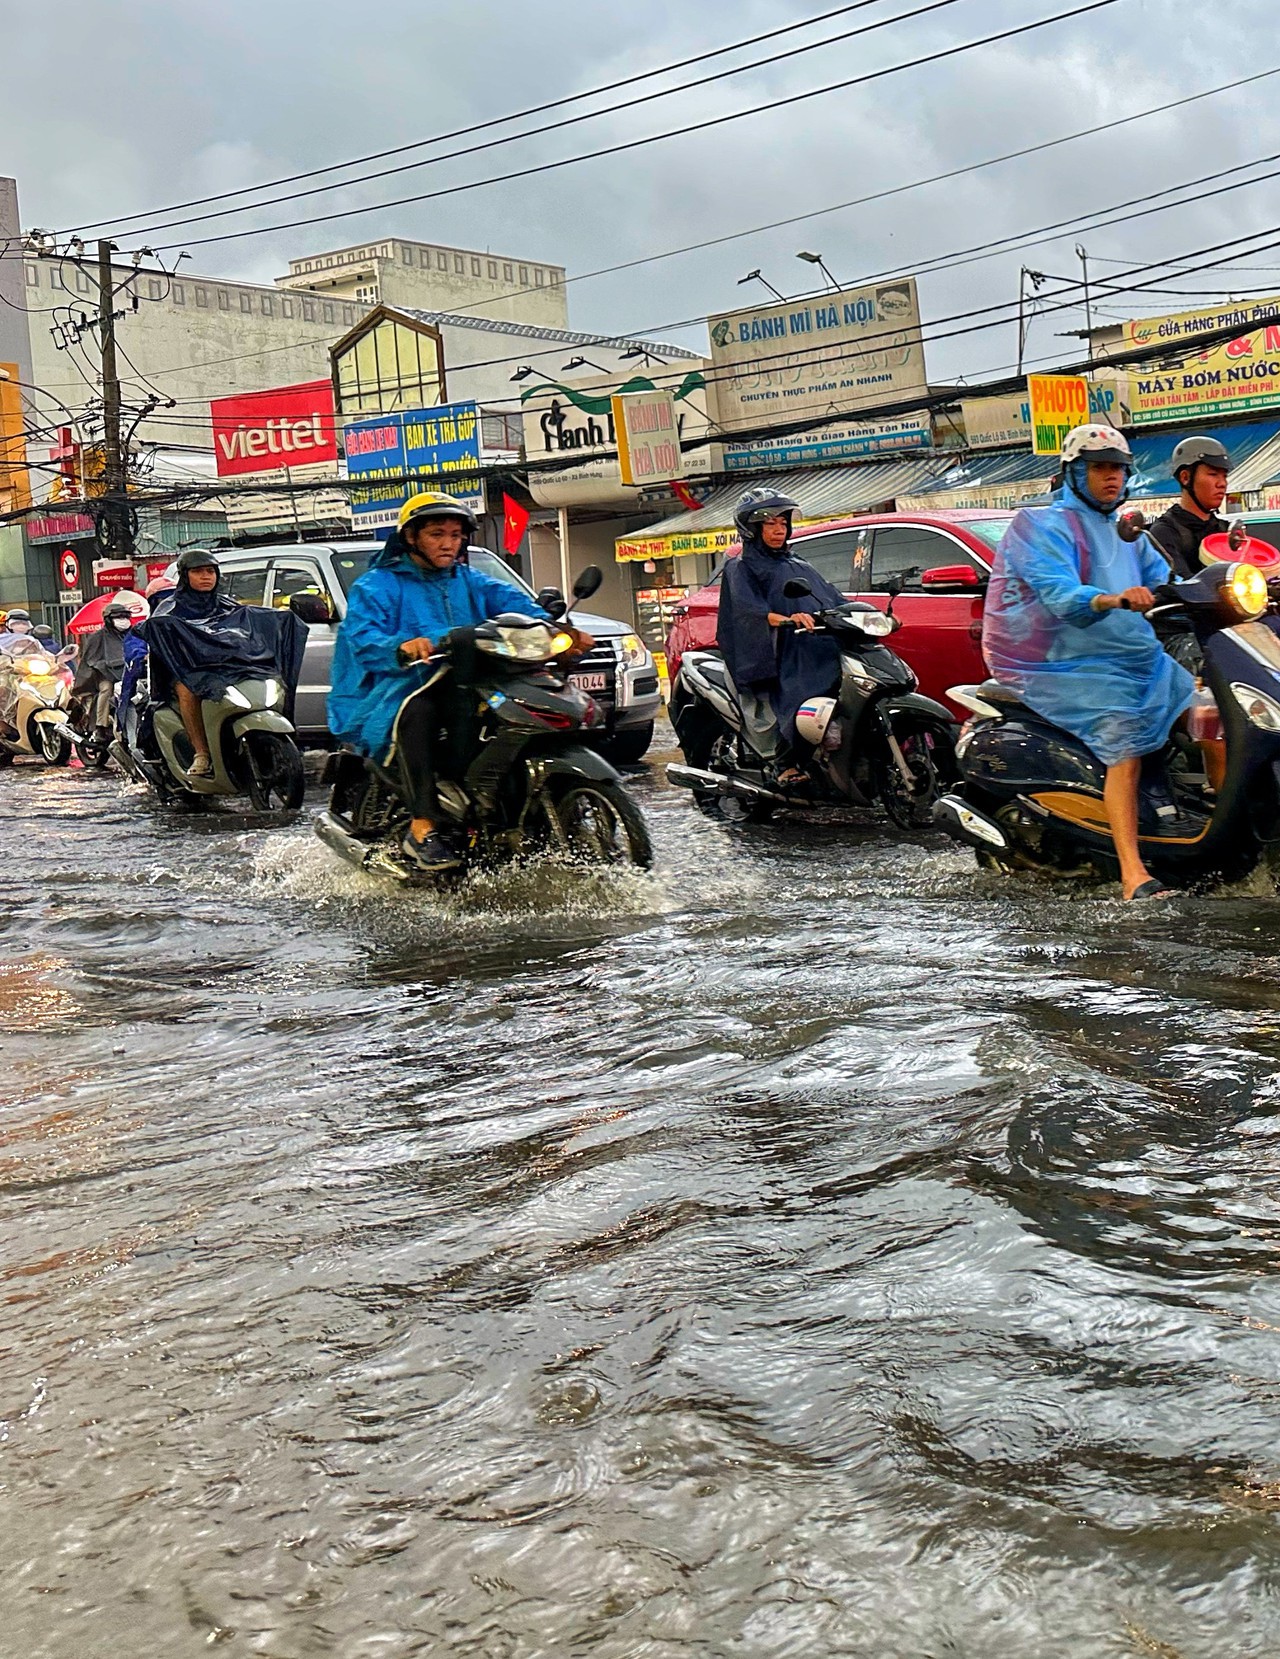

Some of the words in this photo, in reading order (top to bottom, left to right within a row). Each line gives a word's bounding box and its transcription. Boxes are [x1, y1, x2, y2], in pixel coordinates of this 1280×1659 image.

[739, 315, 787, 344] BÁNH
[789, 306, 813, 335] MÌ
[815, 302, 840, 329] HÀ
[844, 297, 876, 328] NỘI
[1158, 319, 1180, 337] CỬA
[1185, 316, 1214, 334] HÀNG
[1217, 309, 1248, 328] PHÂN
[740, 391, 779, 403] CHUYÊN
[782, 386, 806, 399] THỰC
[856, 373, 893, 386] NHANH
[1138, 375, 1176, 395] MÁY
[1182, 368, 1221, 389] BƠM
[1227, 359, 1280, 383] NƯỚC
[1032, 380, 1087, 413] PHOTO
[406, 417, 425, 451] BÁN
[426, 419, 438, 447] XE
[439, 408, 457, 445] TRẢ
[457, 407, 475, 440] GÓP
[628, 399, 659, 435] BÁNH
[218, 412, 329, 460] viettel
[776, 437, 802, 447] Hàng
[806, 434, 818, 443] Và
[821, 432, 844, 441] Giao
[848, 428, 875, 438] Hàng
[879, 424, 898, 434] Tận
[1036, 419, 1057, 450] HÌNH
[634, 441, 655, 477] HÀ
[654, 438, 679, 478] NỘI
[715, 533, 727, 546] XÔI
